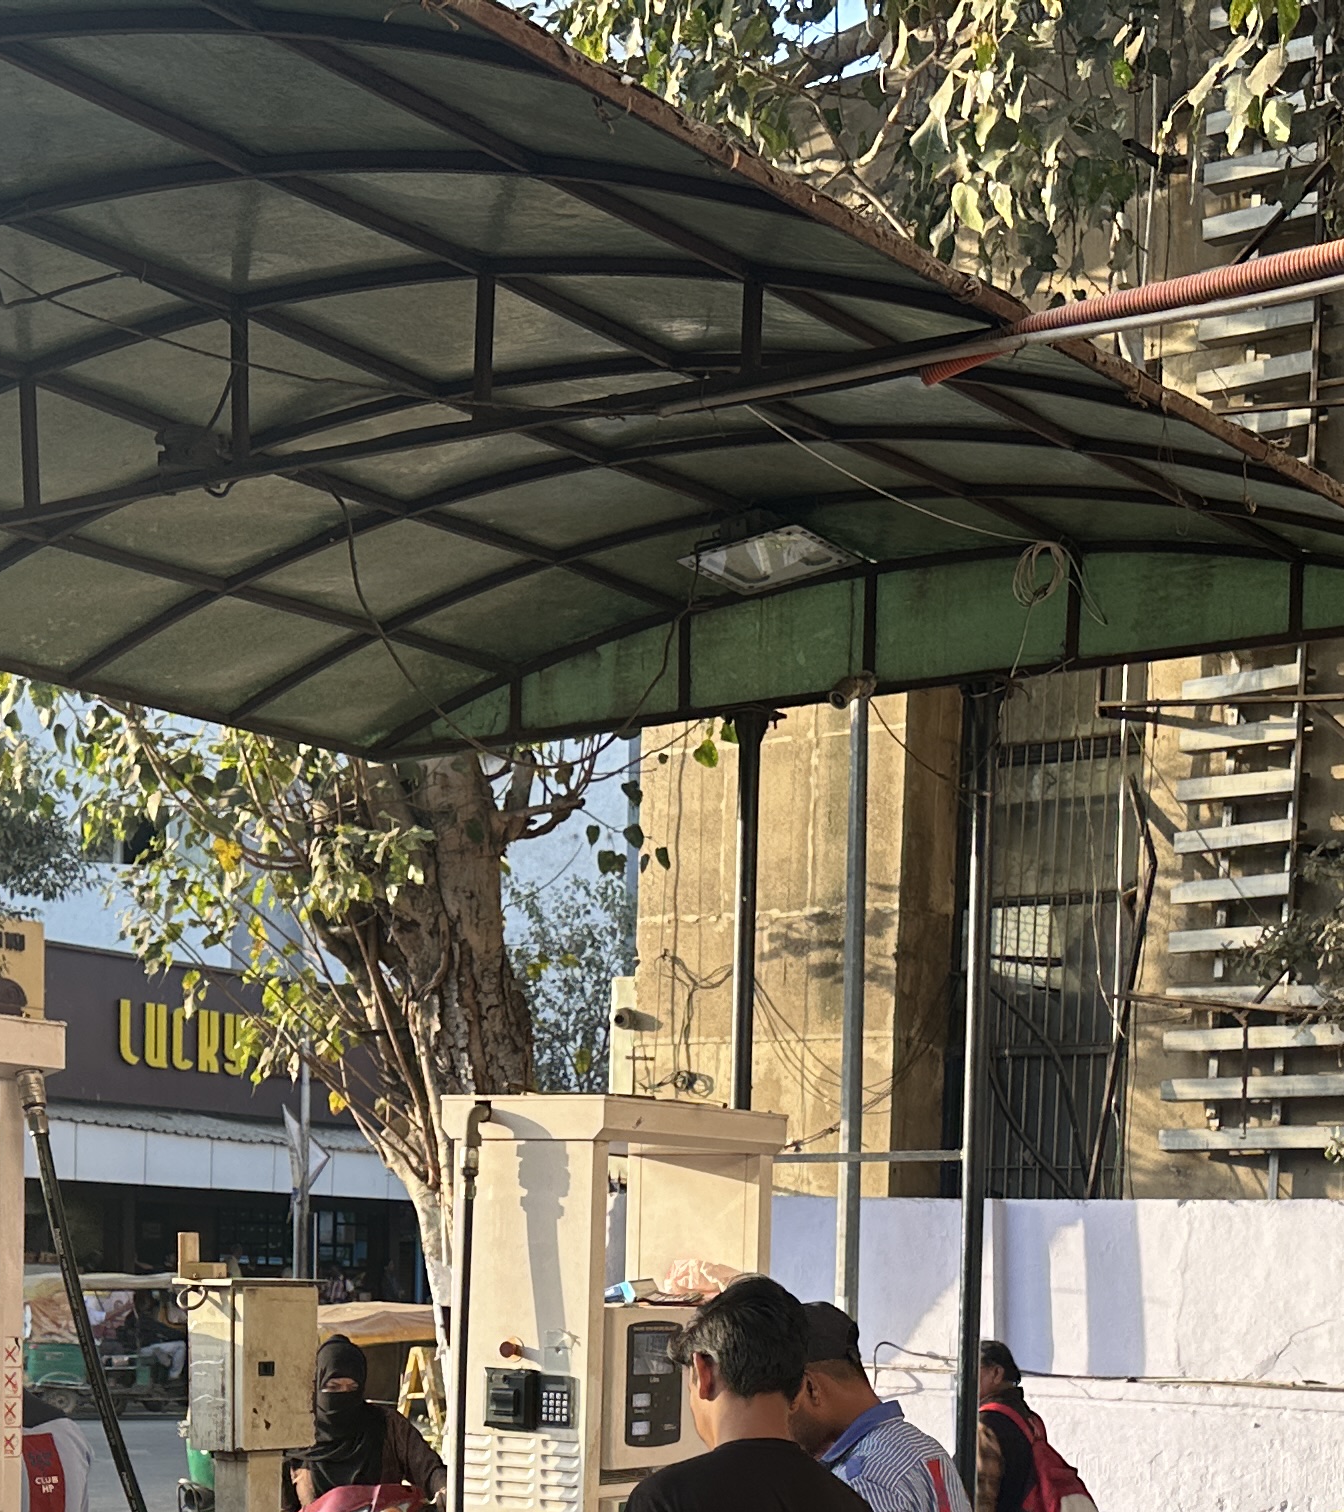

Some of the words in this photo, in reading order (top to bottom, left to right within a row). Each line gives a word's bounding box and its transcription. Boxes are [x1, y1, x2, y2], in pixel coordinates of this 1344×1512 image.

[119, 998, 246, 1076] LUCKY
[34, 1475, 59, 1485] CLUB
[41, 1483, 56, 1494] HP
